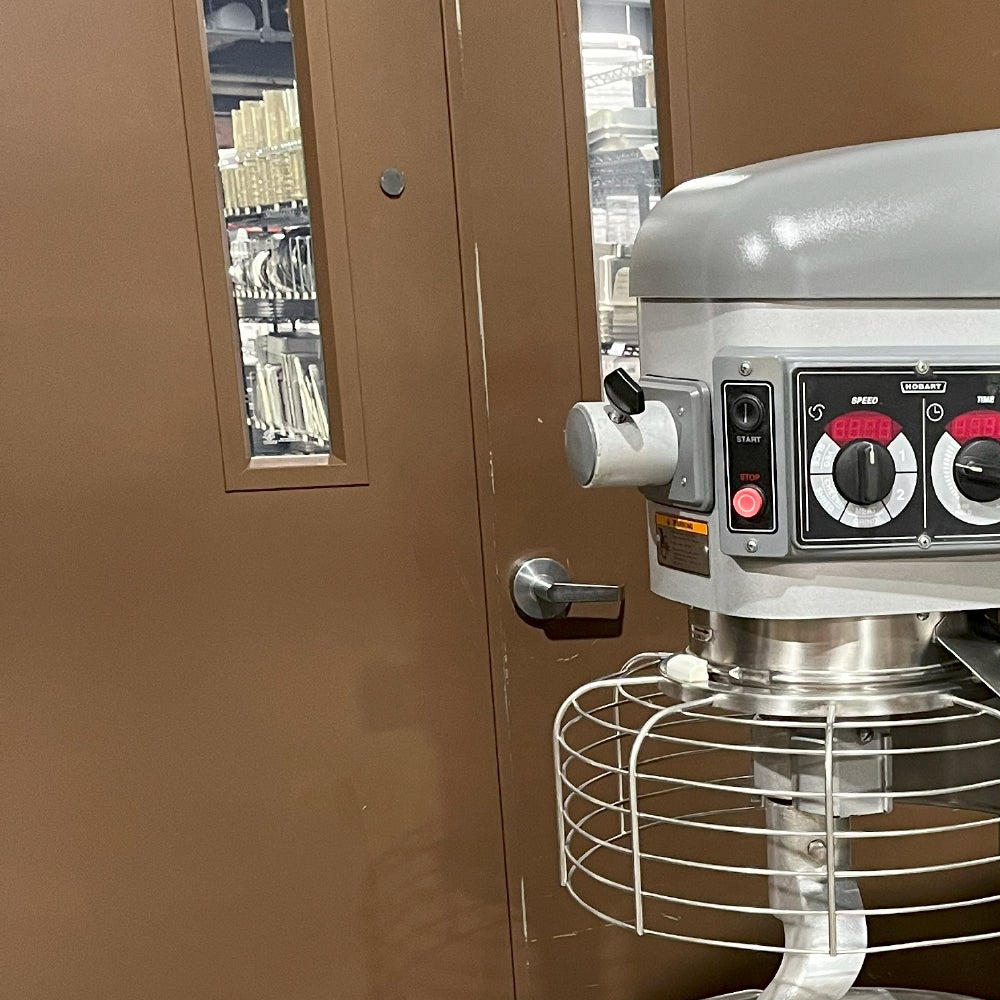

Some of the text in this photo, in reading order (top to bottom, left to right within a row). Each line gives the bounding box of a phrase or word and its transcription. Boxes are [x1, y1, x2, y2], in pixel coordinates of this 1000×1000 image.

[851, 396, 879, 405] SPEED
[977, 395, 995, 404] TIME
[736, 435, 762, 443] START
[898, 449, 905, 462] 1
[739, 473, 761, 482] STOP
[896, 488, 905, 501] 2
